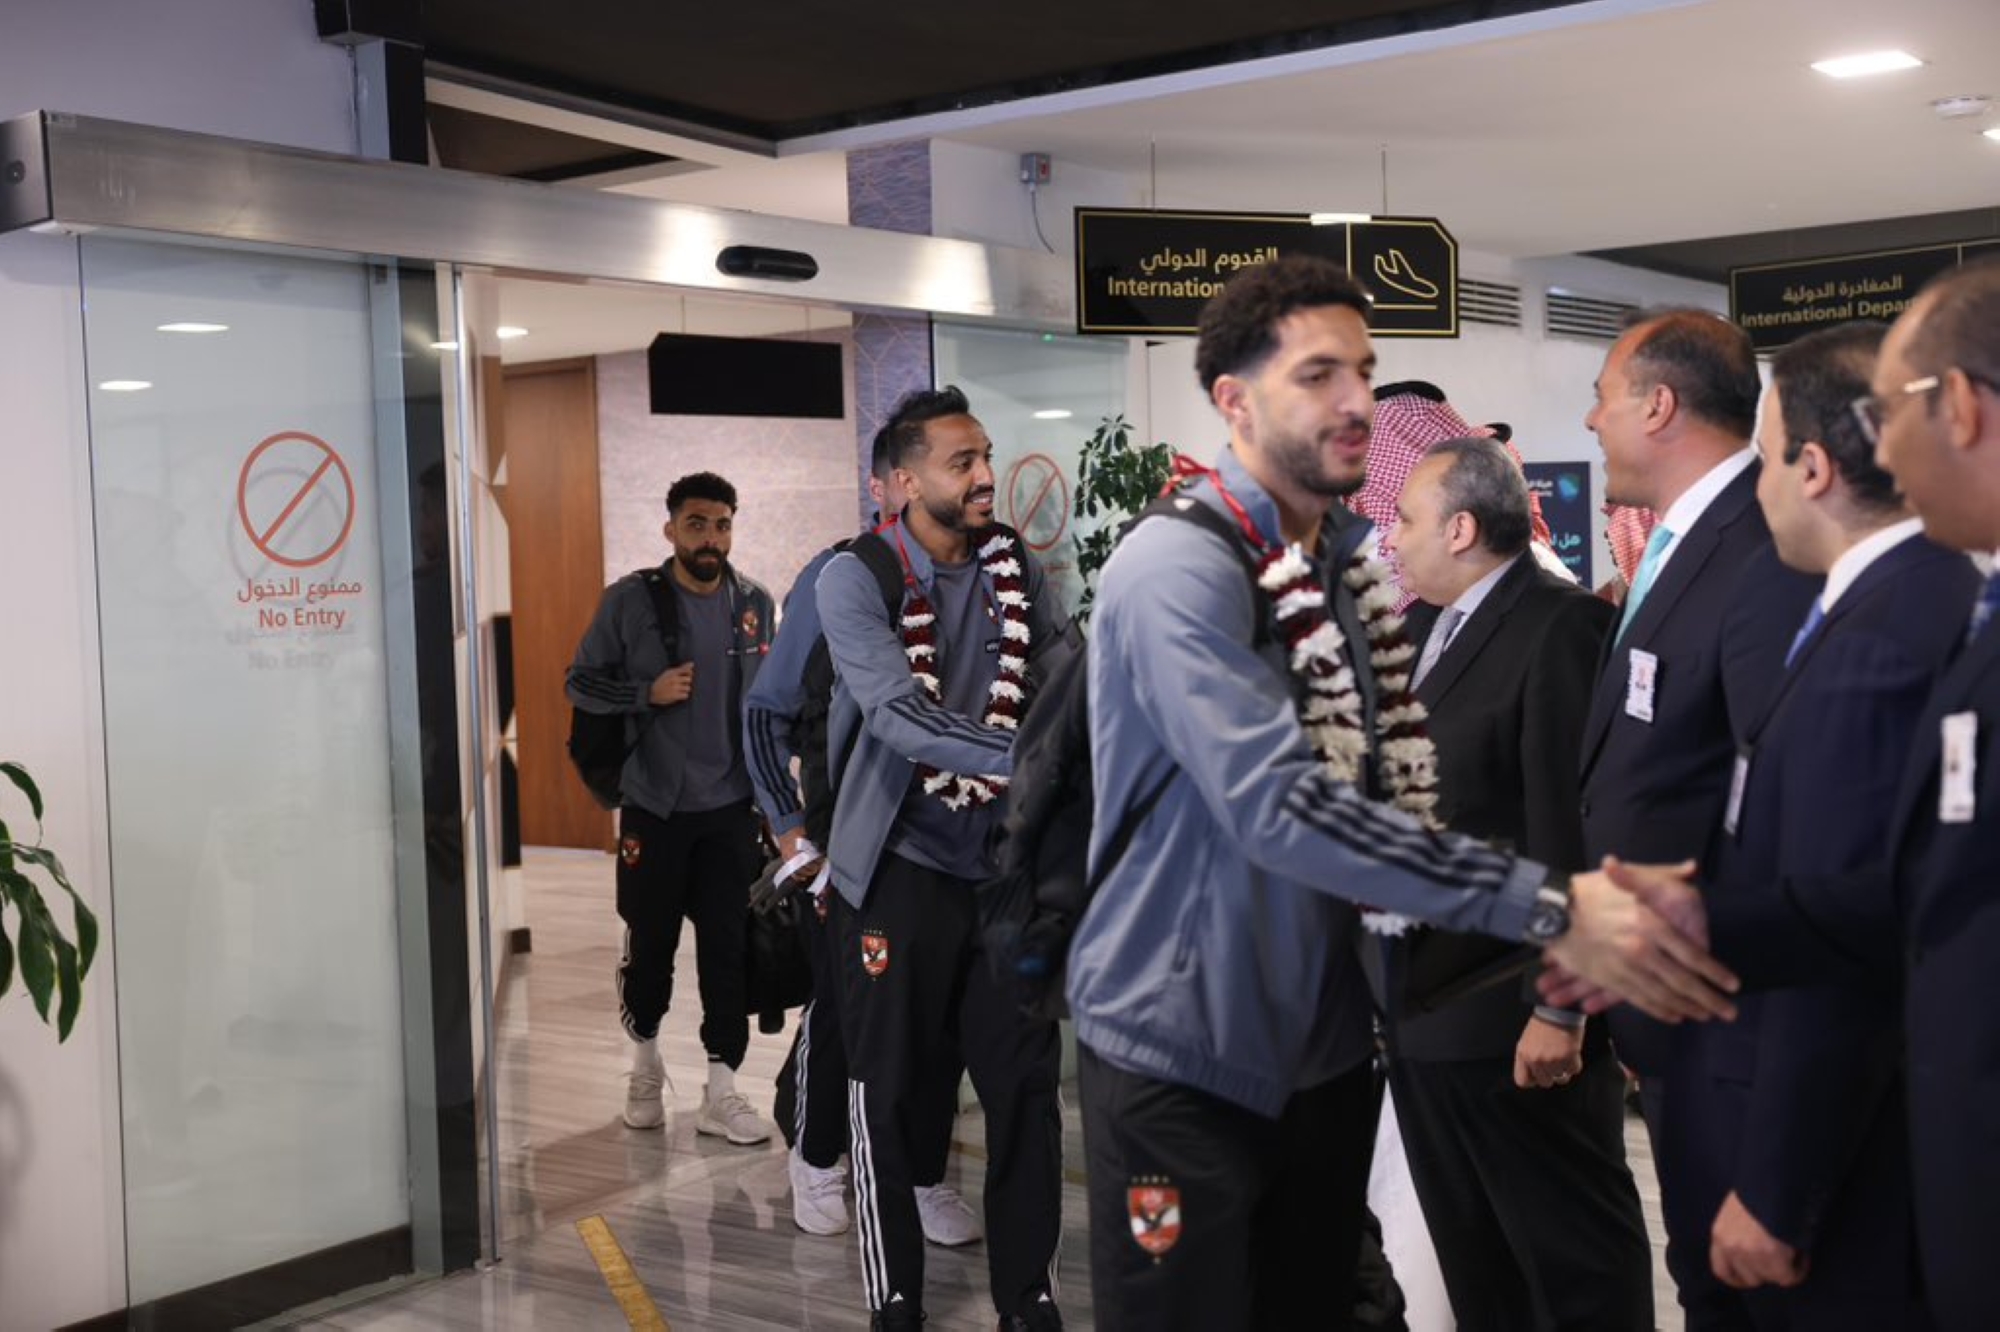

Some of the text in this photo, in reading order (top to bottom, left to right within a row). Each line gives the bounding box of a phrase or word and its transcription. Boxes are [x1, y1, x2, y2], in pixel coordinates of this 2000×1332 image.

[1139, 246, 1278, 276] القدوم الدولي
[1107, 275, 1226, 299] Internation
[1782, 275, 1903, 304] المغادرة الدولية
[1741, 297, 1914, 328] International Depar
[237, 577, 362, 604] ممنوع الدخول
[259, 608, 347, 630] No Entry
